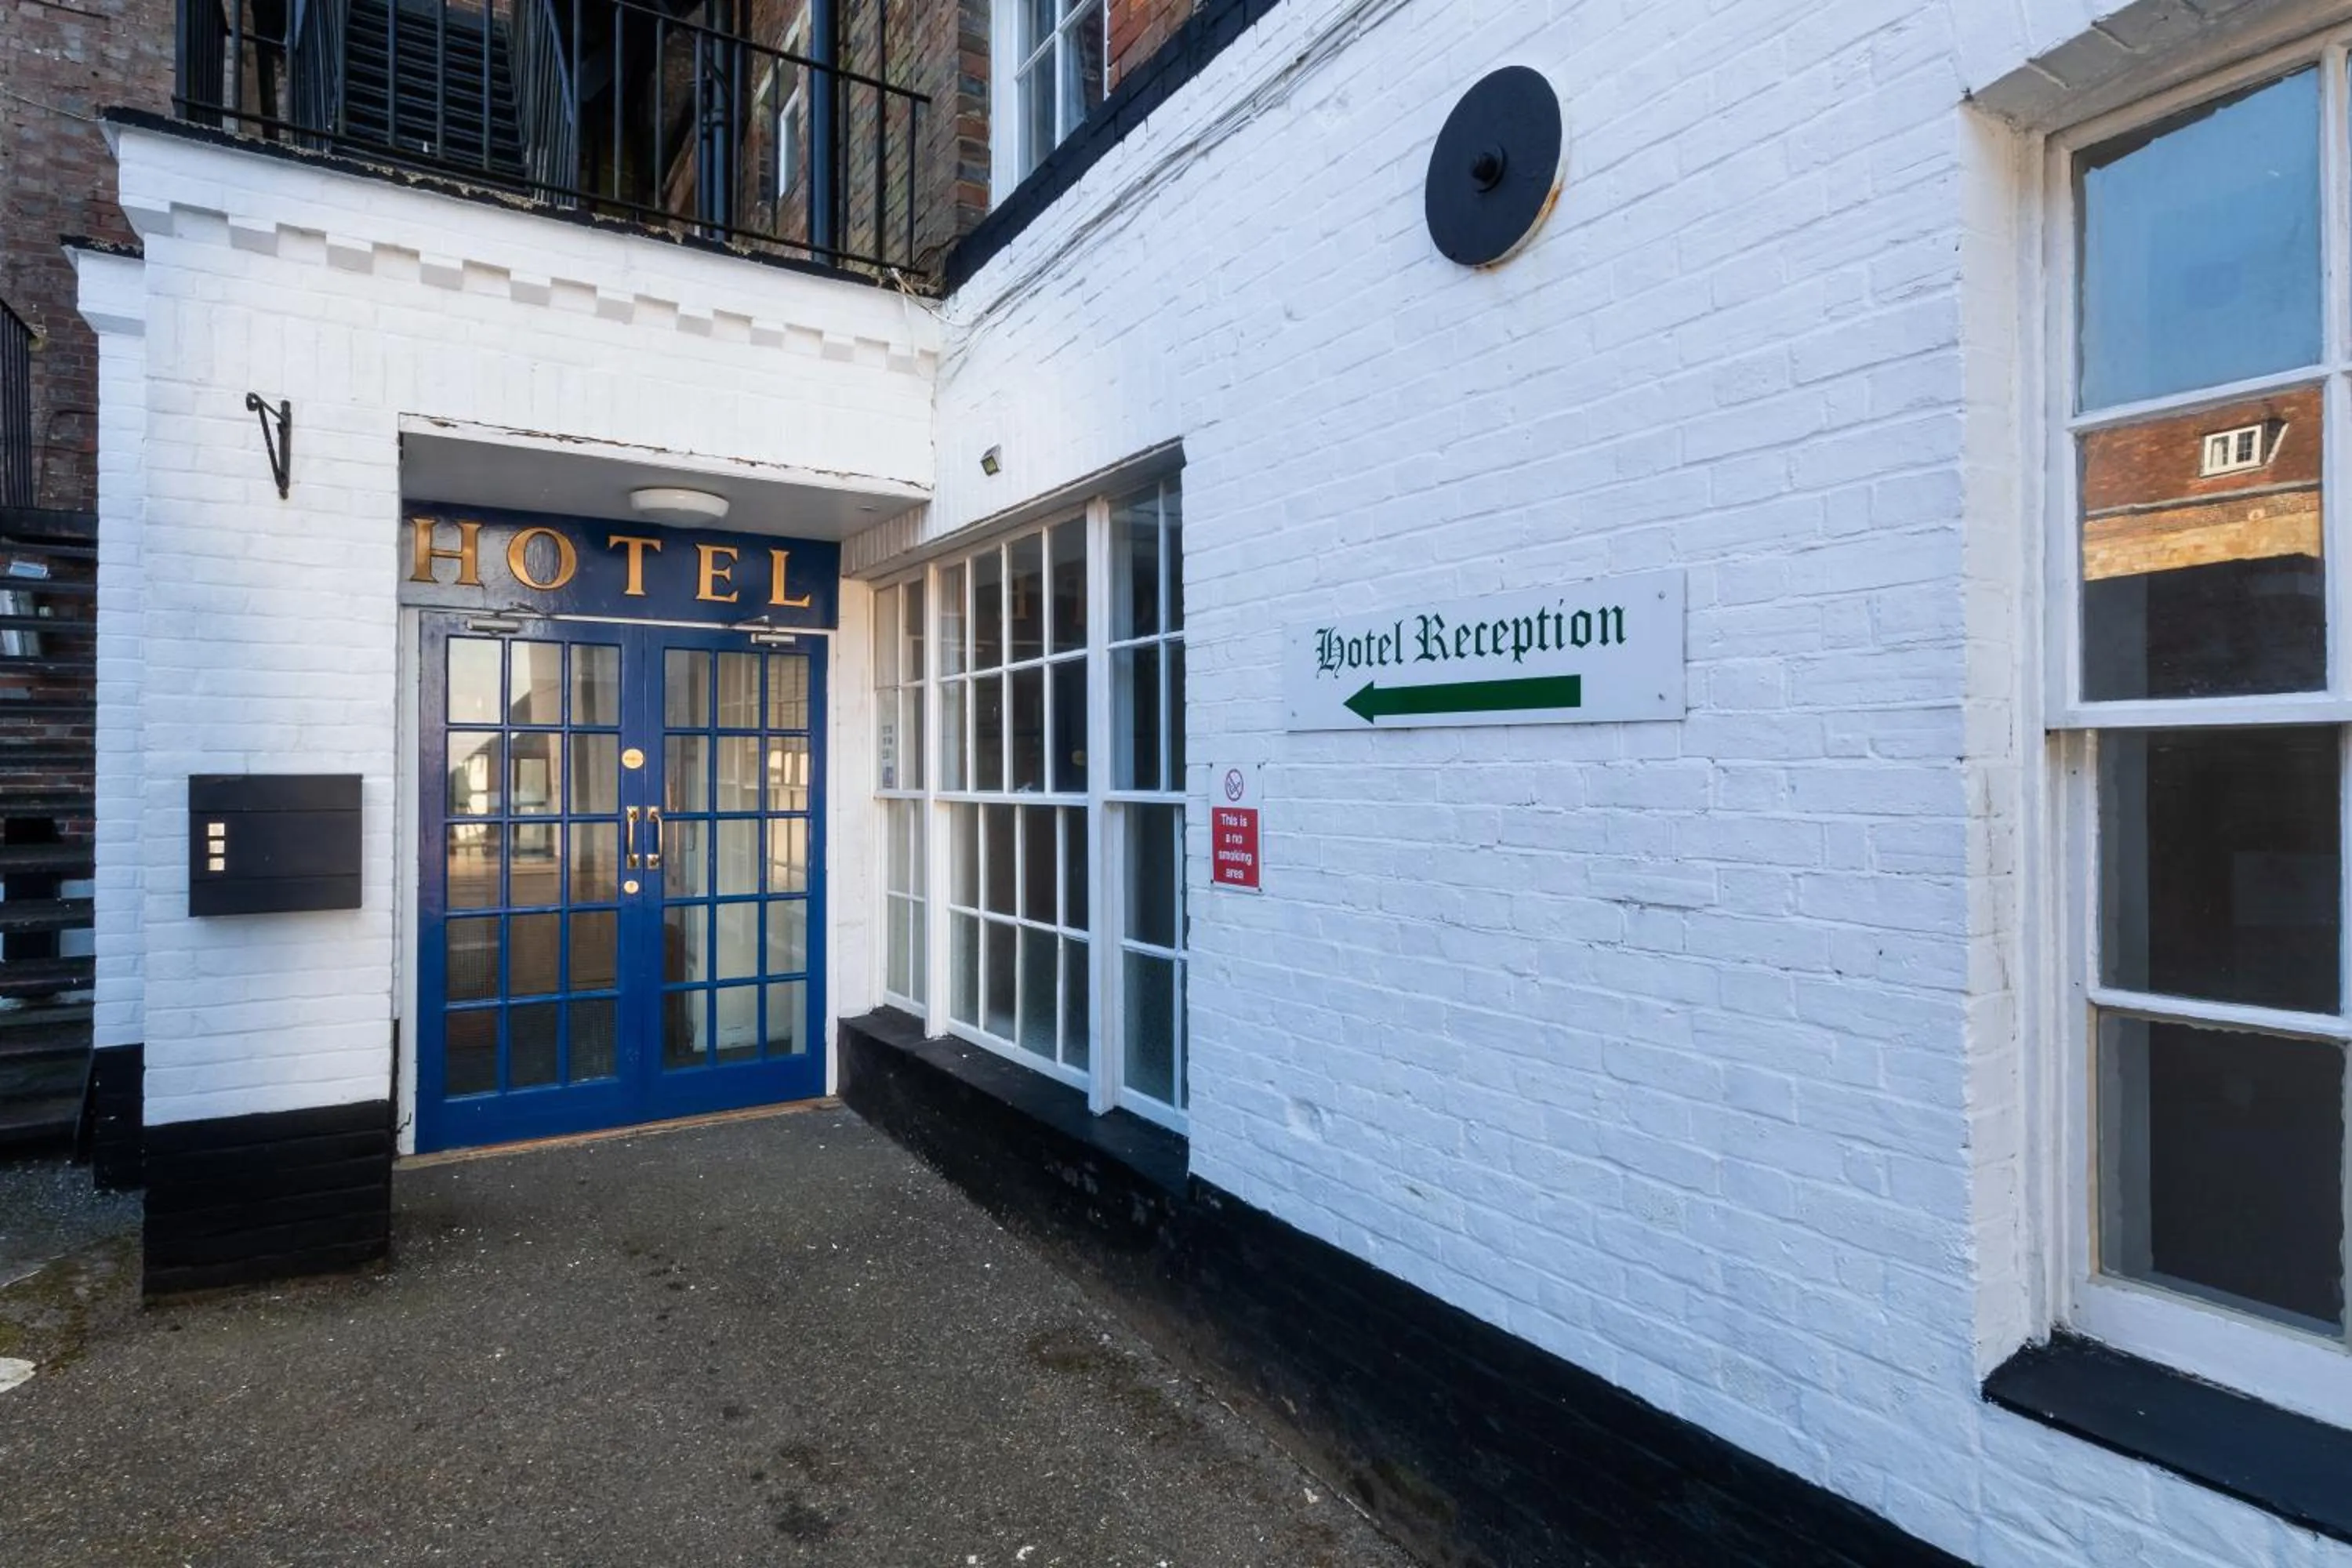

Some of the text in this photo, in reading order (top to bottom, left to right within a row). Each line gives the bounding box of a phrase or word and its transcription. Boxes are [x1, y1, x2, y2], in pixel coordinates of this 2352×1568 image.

[408, 516, 811, 608] HOTEL
[1315, 598, 1627, 679] Hotel Reception
[1221, 813, 1248, 827] This is
[1225, 833, 1243, 844] a no
[1218, 850, 1252, 866] smoking
[1225, 868, 1244, 880] area
